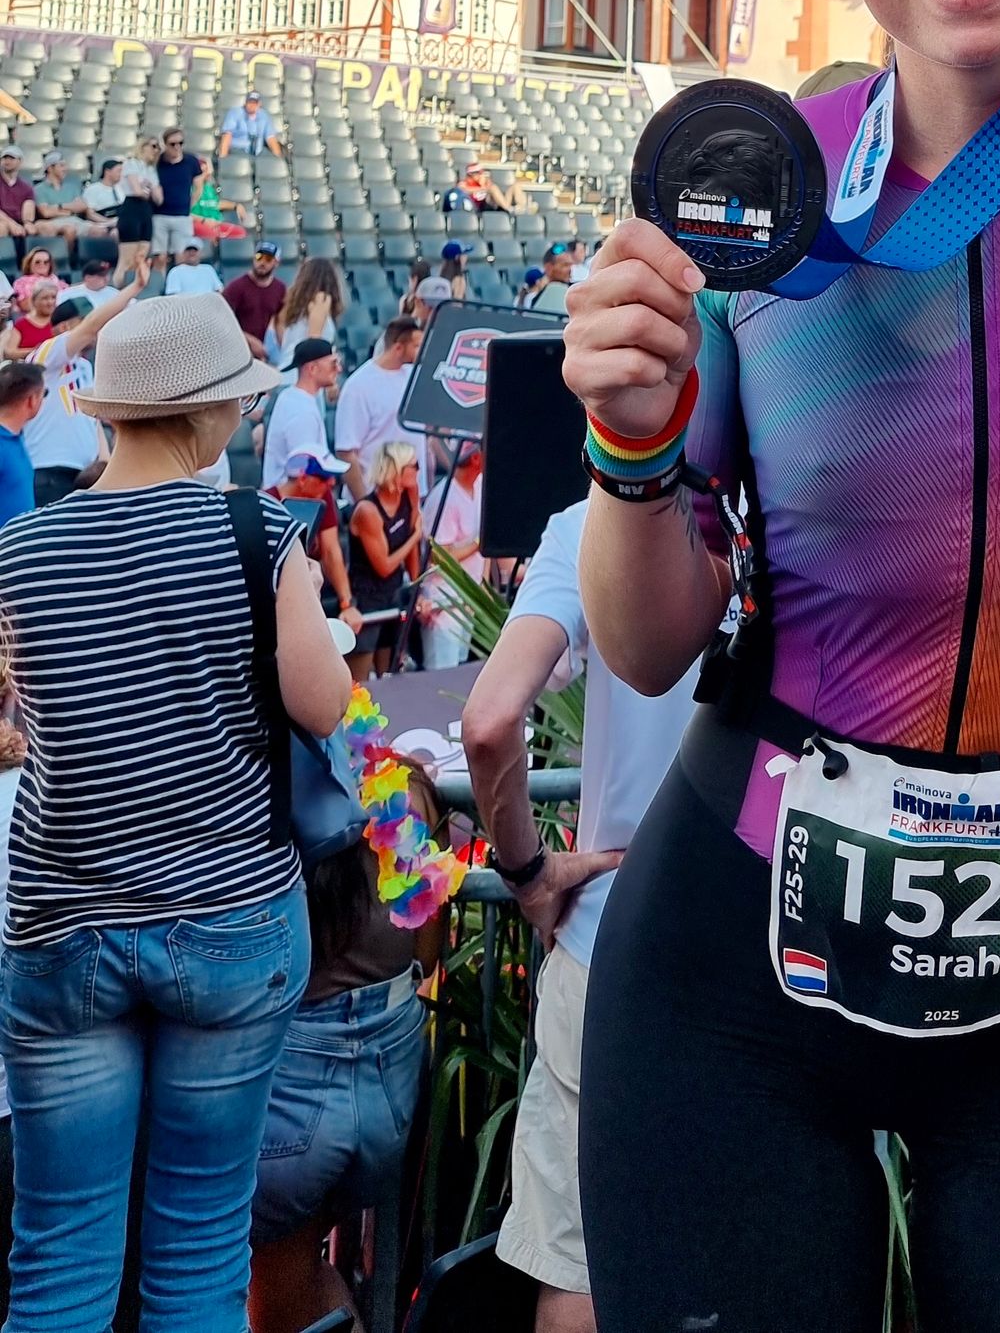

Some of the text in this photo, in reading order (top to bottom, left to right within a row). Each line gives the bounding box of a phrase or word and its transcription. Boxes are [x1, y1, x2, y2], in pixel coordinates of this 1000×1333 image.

[859, 105, 885, 195] IRONMAN
[689, 191, 727, 203] mainova
[677, 199, 773, 228] IRONMAN
[676, 221, 753, 239] FRANKFURT
[905, 782, 952, 799] mainova
[890, 813, 988, 836] FRANKFURT
[783, 824, 810, 923] F25-29
[889, 944, 1000, 979] Sarah
[923, 1009, 960, 1023] 2025
